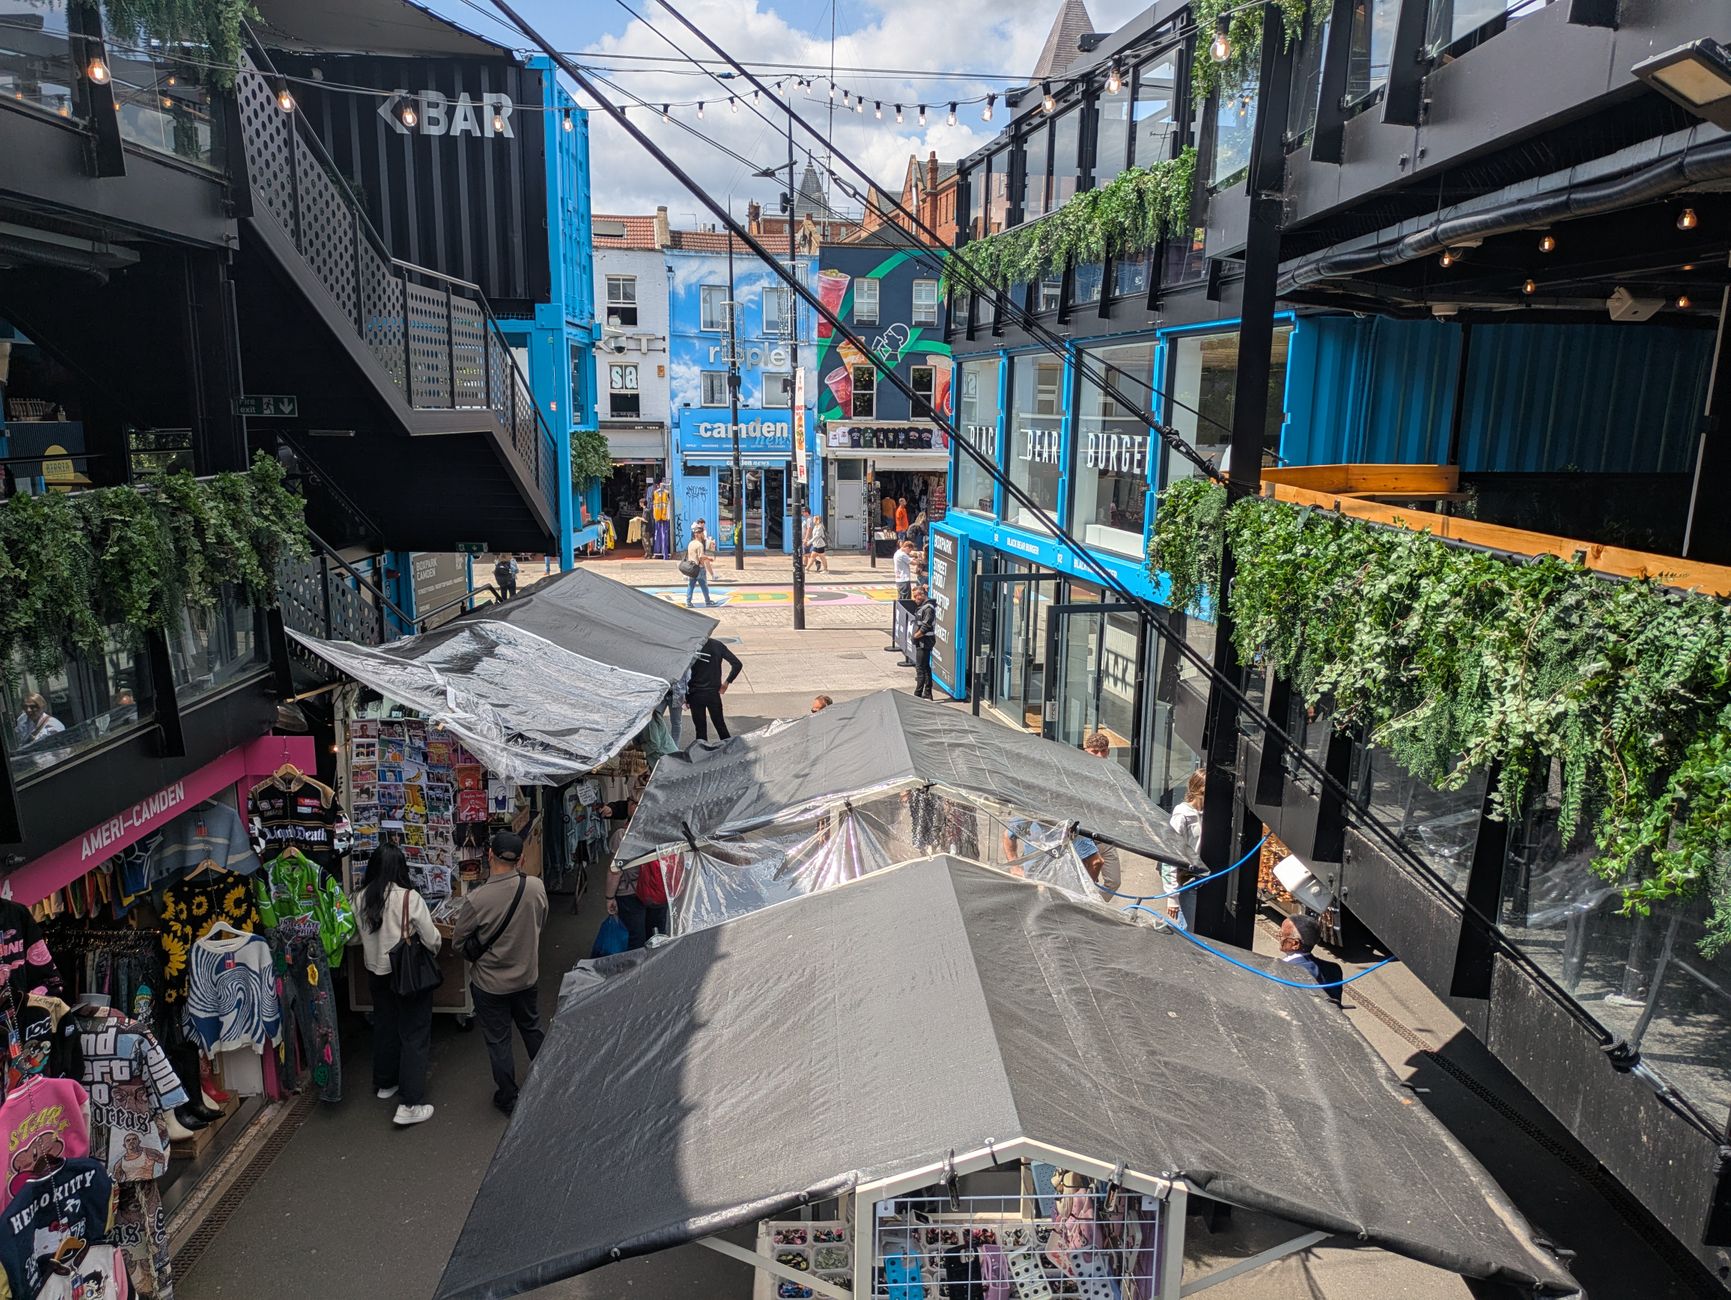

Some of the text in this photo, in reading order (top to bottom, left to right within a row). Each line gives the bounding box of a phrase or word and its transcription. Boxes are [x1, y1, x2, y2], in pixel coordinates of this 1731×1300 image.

[418, 89, 515, 139] BAR
[1026, 429, 1058, 465] BEAR
[296, 825, 328, 842] Death
